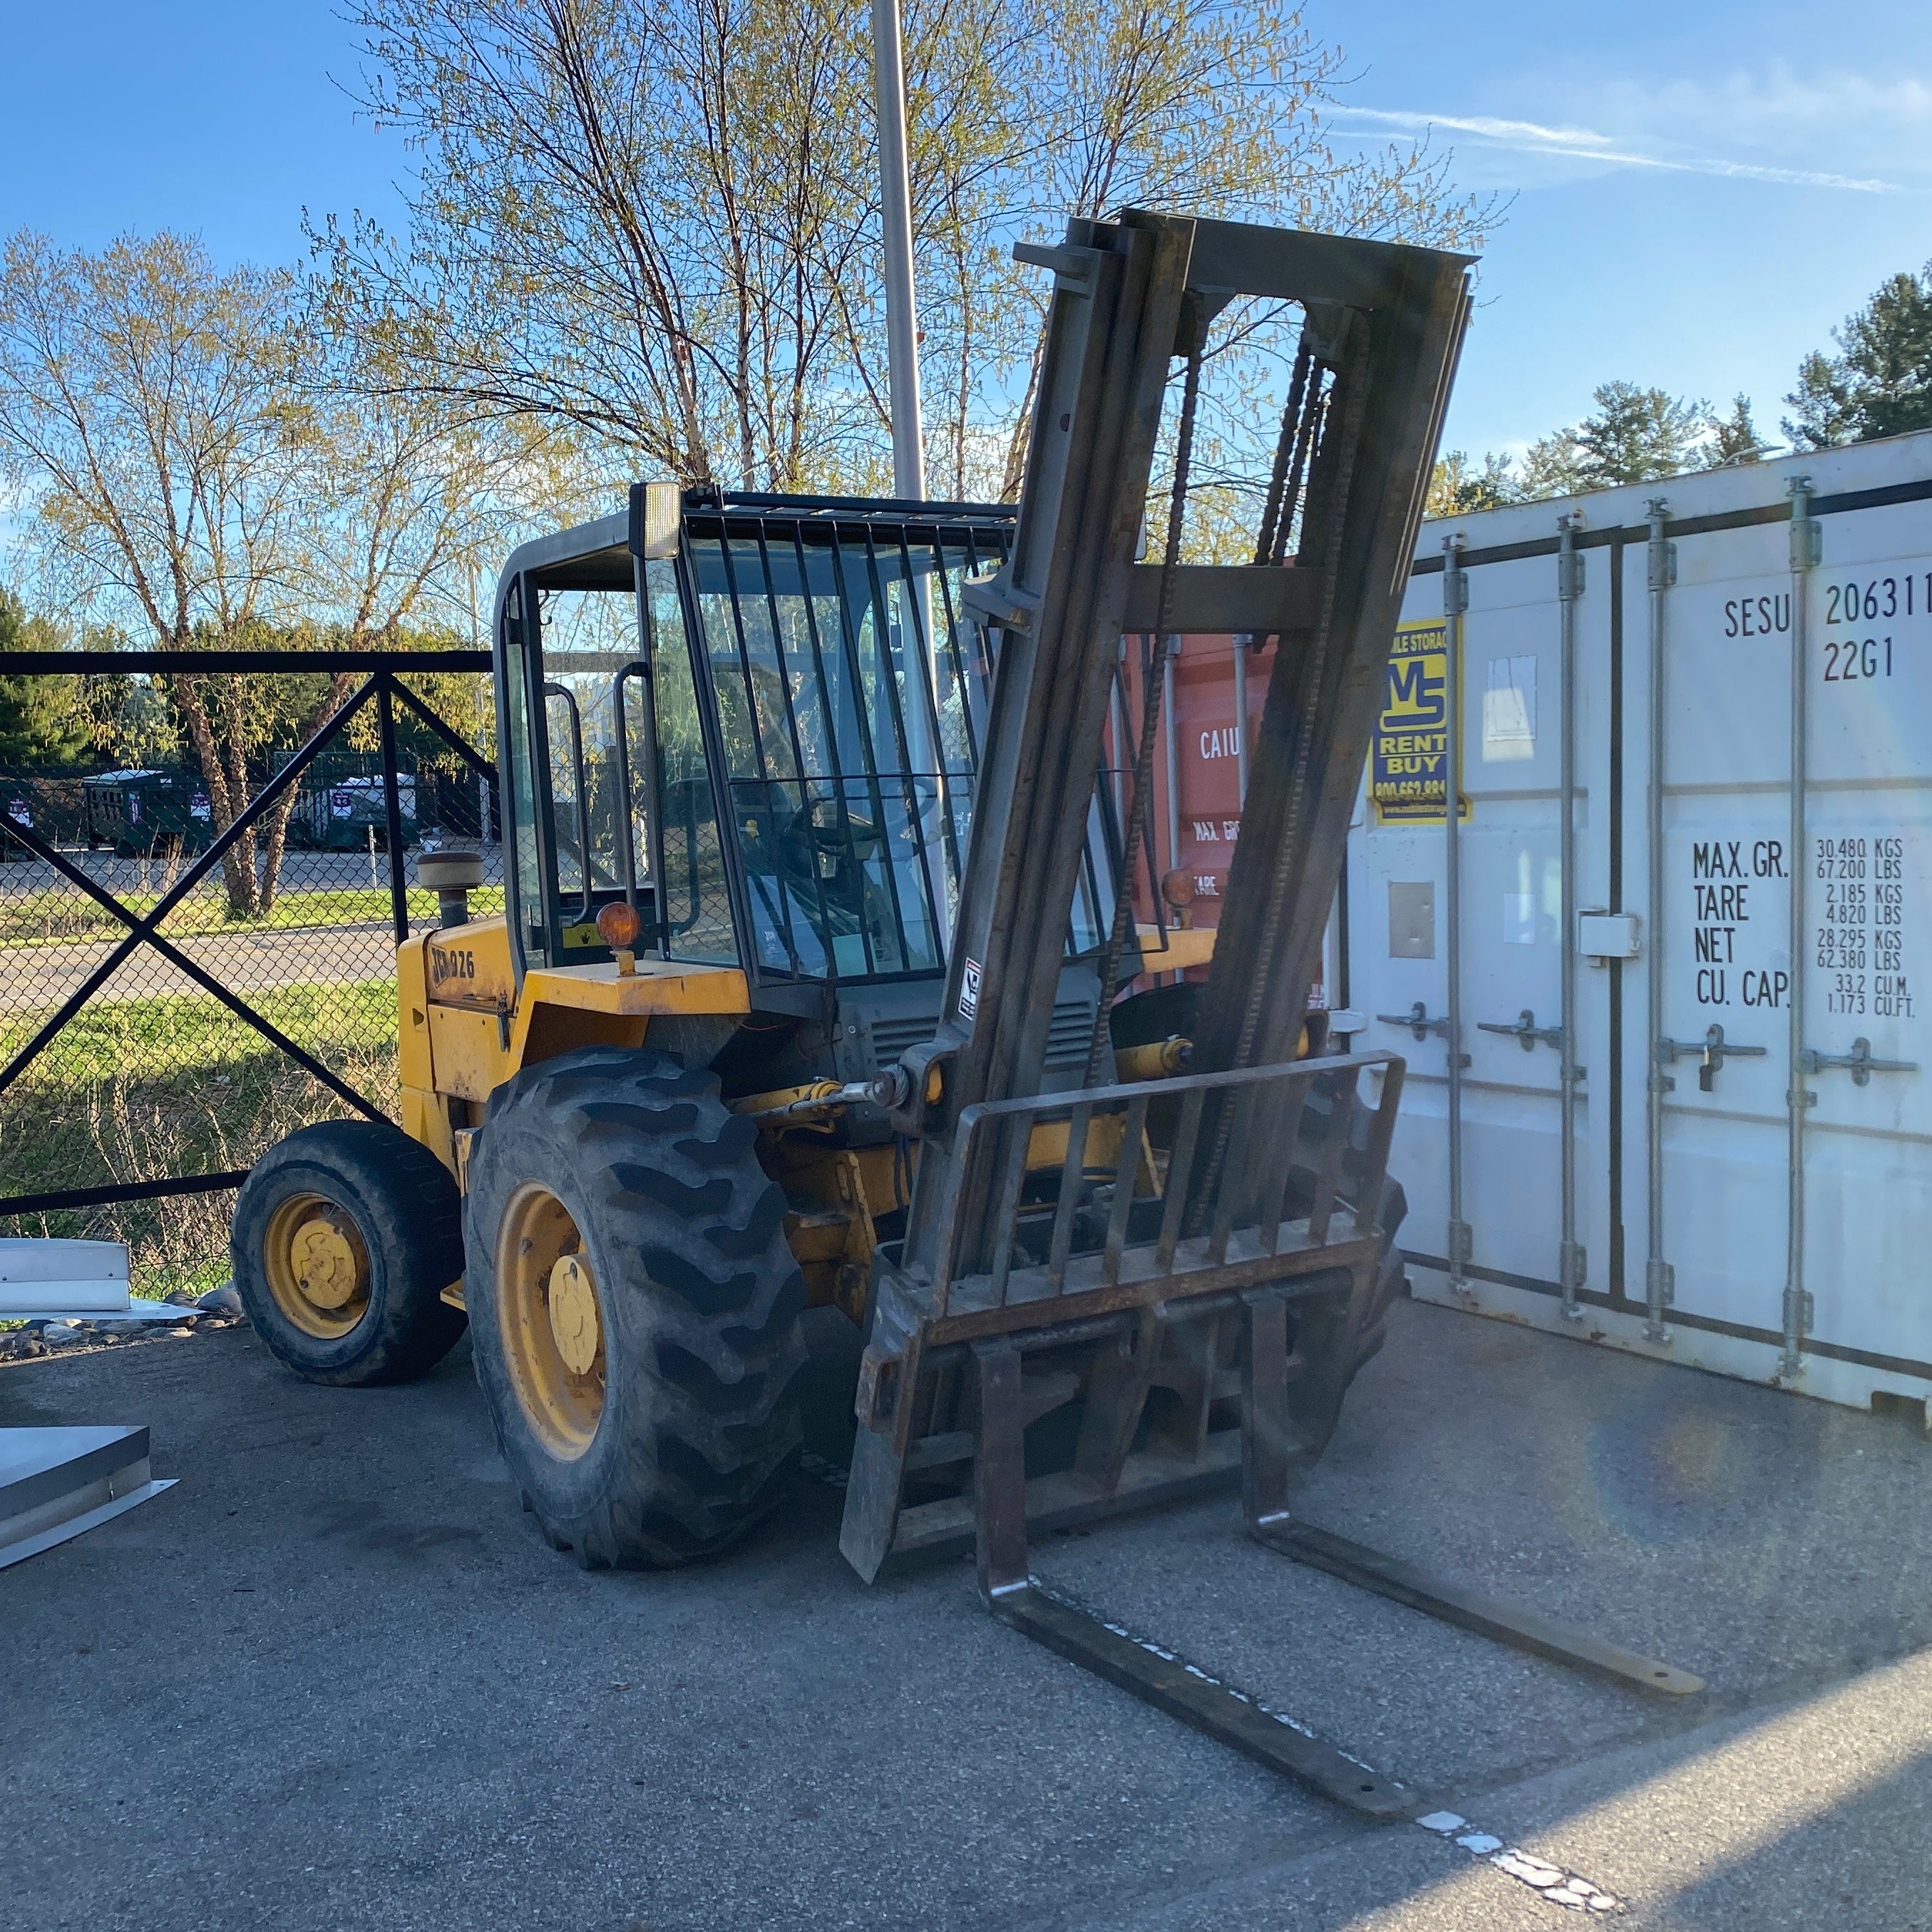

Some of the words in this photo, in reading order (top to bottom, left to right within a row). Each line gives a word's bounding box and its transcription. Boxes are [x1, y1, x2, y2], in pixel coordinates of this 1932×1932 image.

[1725, 593, 1790, 637] SESU
[1824, 637, 1893, 681] 22G1
[1200, 726, 1239, 759] CAIU
[1379, 734, 1447, 754] RENT
[1387, 756, 1441, 775] BUY
[1874, 838, 1903, 858] KGS
[1817, 860, 1866, 879] 67.200
[1874, 860, 1902, 879] LBS
[1694, 885, 1749, 921] TARE
[1826, 884, 1866, 903] 2.185
[1874, 884, 1903, 904] KGS
[1826, 905, 1866, 925] 4.820
[1874, 905, 1902, 925] LBS
[1695, 928, 1736, 963] NET
[1817, 928, 1866, 948] 28.295
[1874, 929, 1903, 950] KGS
[450, 950, 474, 979] 926
[1817, 949, 1866, 969] 62.380
[1874, 950, 1901, 970] LBS
[1697, 969, 1730, 1005] CU.
[1742, 970, 1791, 1008] CAP.
[1836, 974, 1866, 994] 33.2
[1827, 994, 1866, 1014] 1.173
